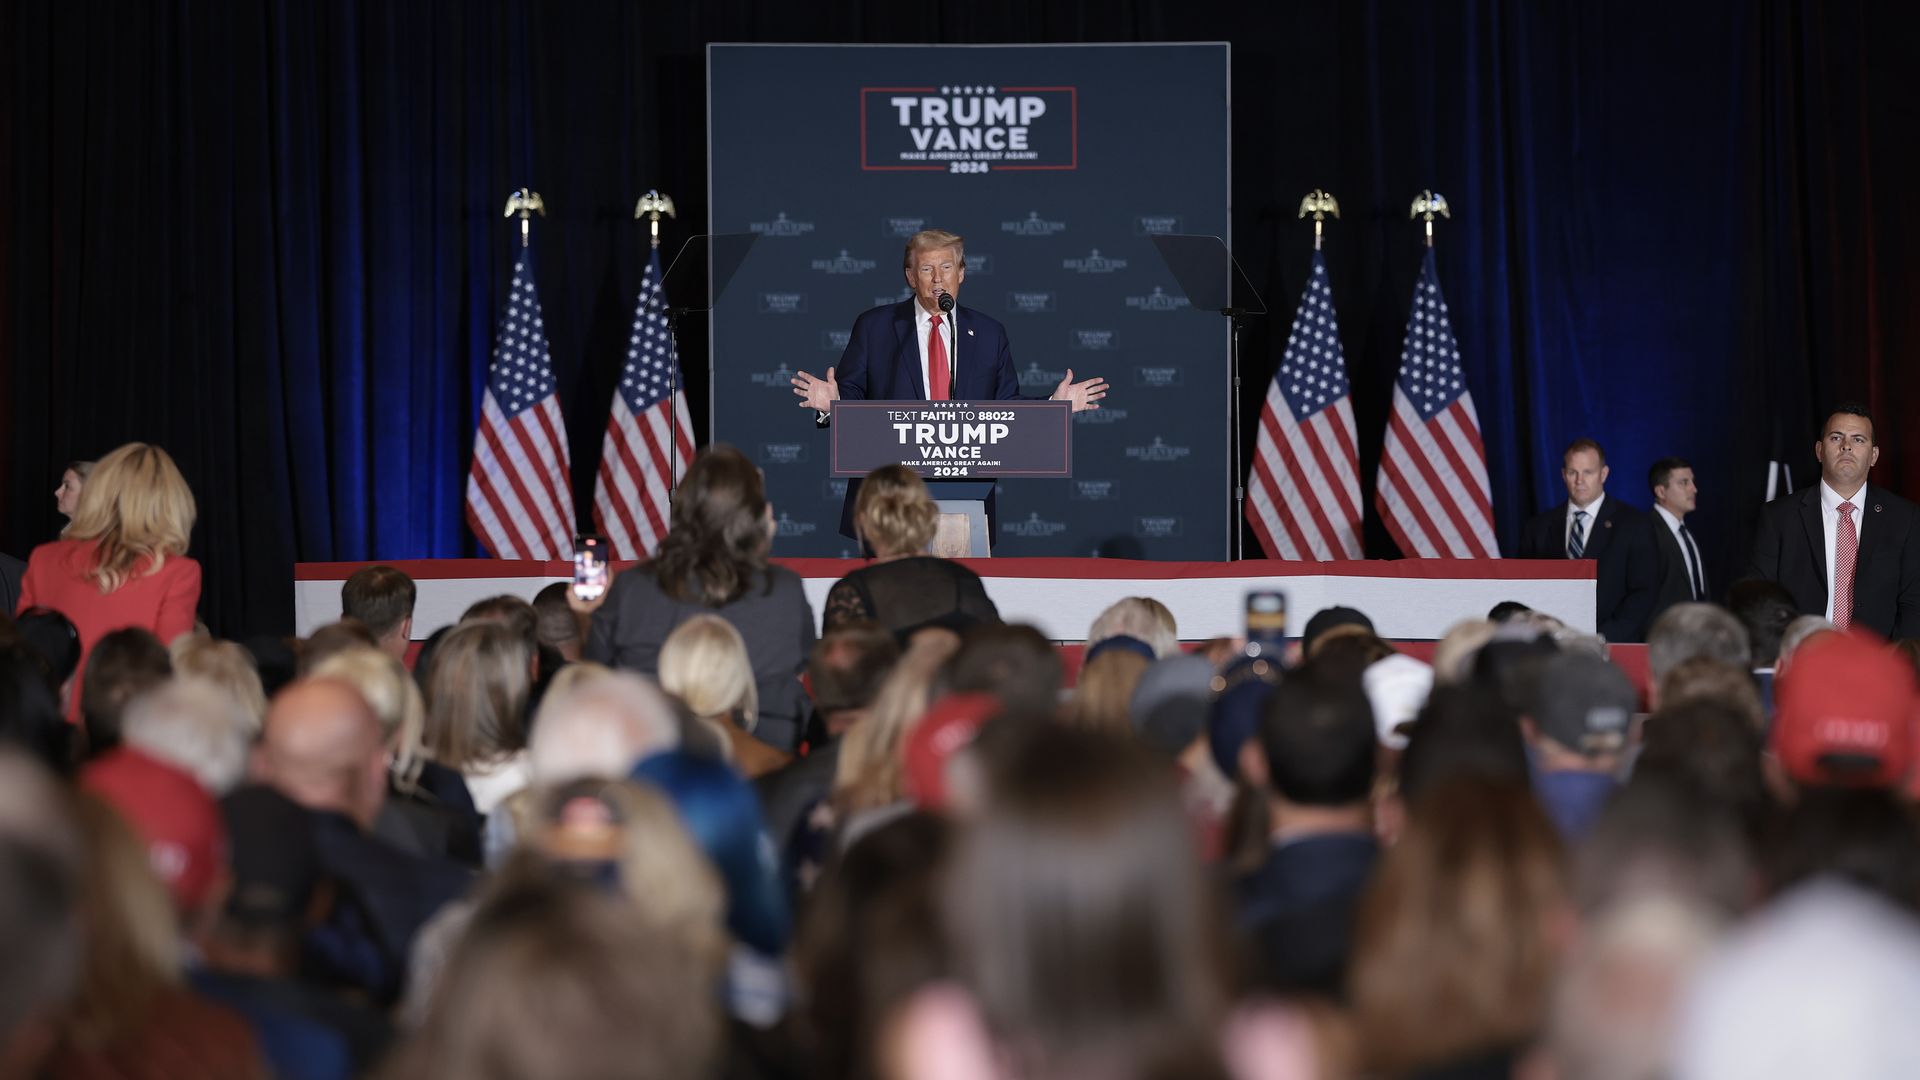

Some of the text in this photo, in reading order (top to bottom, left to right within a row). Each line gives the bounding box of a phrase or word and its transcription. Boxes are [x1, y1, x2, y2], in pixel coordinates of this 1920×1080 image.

[890, 96, 1047, 126] TRUMP
[910, 126, 1029, 151] VANCE
[900, 151, 1038, 161] MAKE AMERICA GREAT AGAIN!
[949, 161, 989, 174] 2024
[887, 411, 1015, 421] TEXT FAITH TO 88022
[893, 423, 1009, 444] TRUMP
[919, 446, 981, 459] VANCE
[933, 467, 968, 476] 2024
